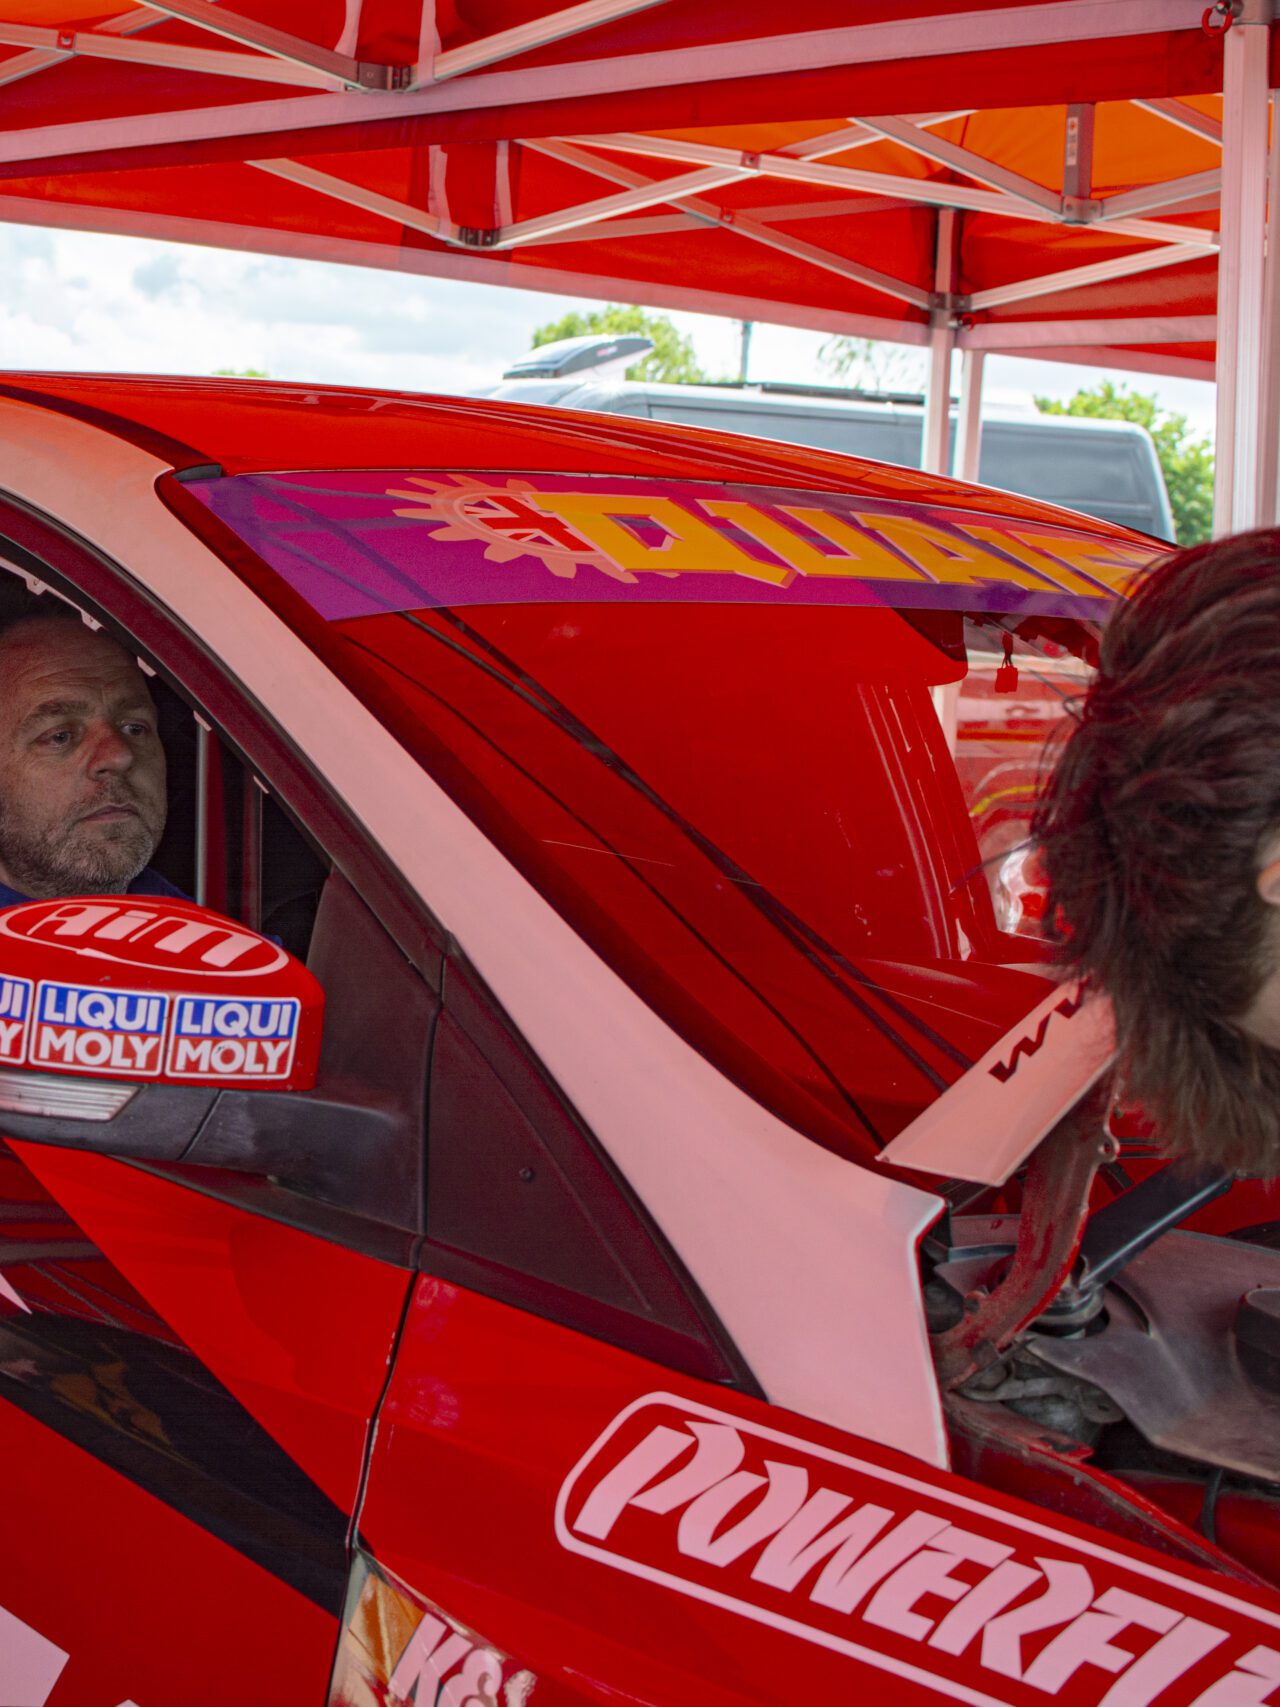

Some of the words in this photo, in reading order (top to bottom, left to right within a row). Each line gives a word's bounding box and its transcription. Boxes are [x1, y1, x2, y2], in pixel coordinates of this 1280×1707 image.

[43, 986, 159, 1033] LIQUI
[181, 1000, 293, 1039] LIQUI
[38, 1027, 161, 1070] MOLY
[175, 1039, 292, 1075] MOLY
